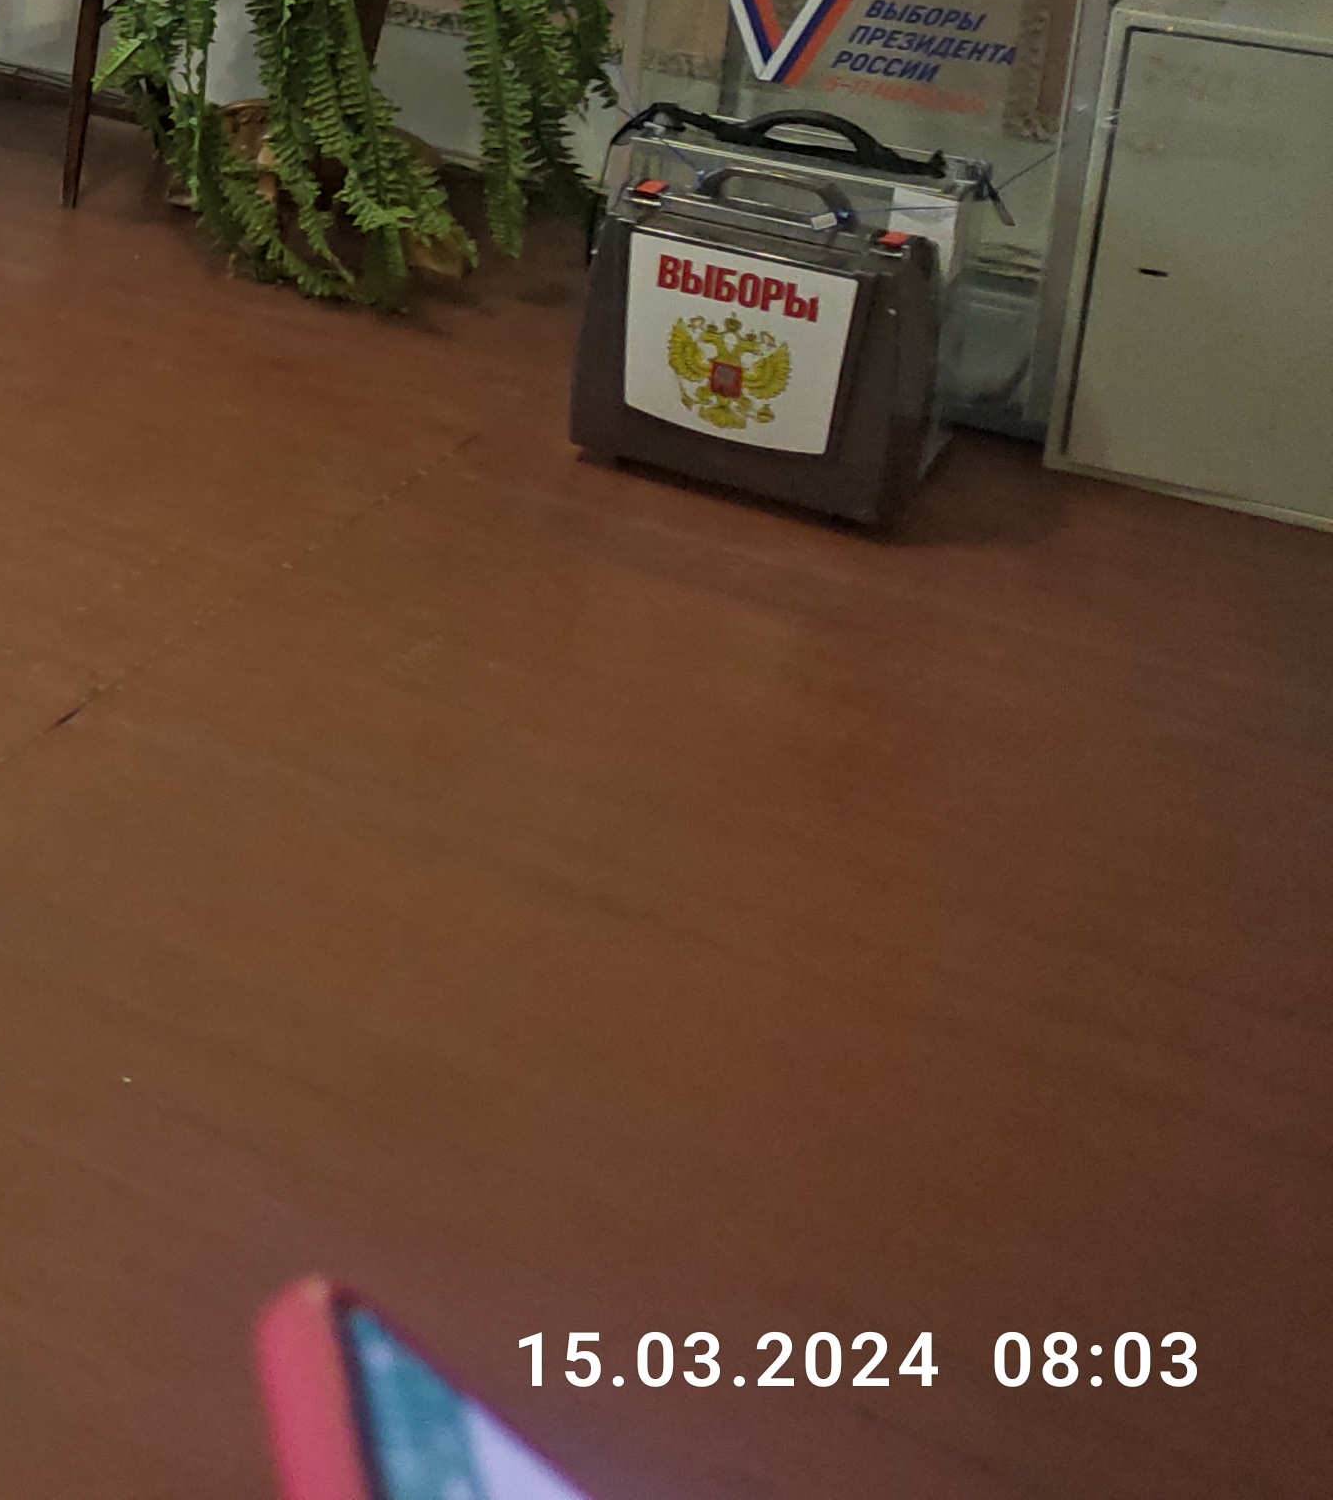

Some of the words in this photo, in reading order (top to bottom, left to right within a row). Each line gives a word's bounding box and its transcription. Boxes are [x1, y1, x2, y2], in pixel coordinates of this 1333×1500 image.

[865, 0, 987, 32] ВЫБОРЫ
[848, 25, 1018, 66] ПРЕЗИДЕНТА
[831, 50, 941, 83] РОССИИ
[656, 253, 820, 323] ВЫБОРЫ
